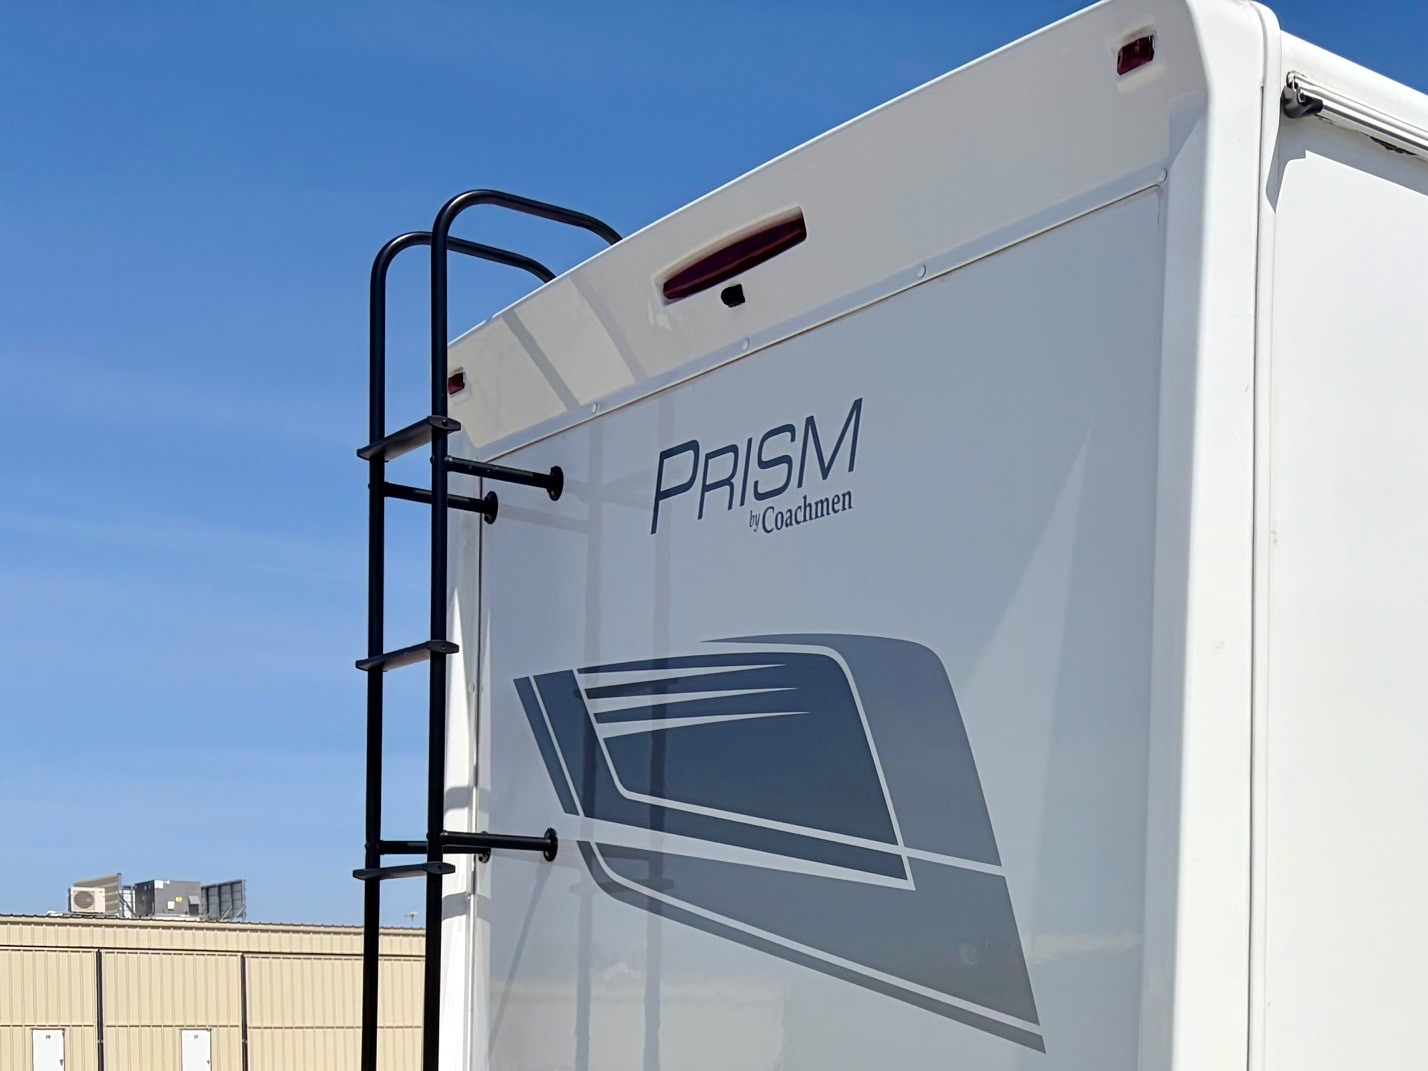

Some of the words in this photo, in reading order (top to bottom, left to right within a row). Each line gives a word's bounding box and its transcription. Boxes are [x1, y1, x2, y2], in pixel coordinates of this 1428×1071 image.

[650, 397, 863, 535] PRISM
[749, 510, 761, 533] by
[761, 490, 853, 534] Coachmen
